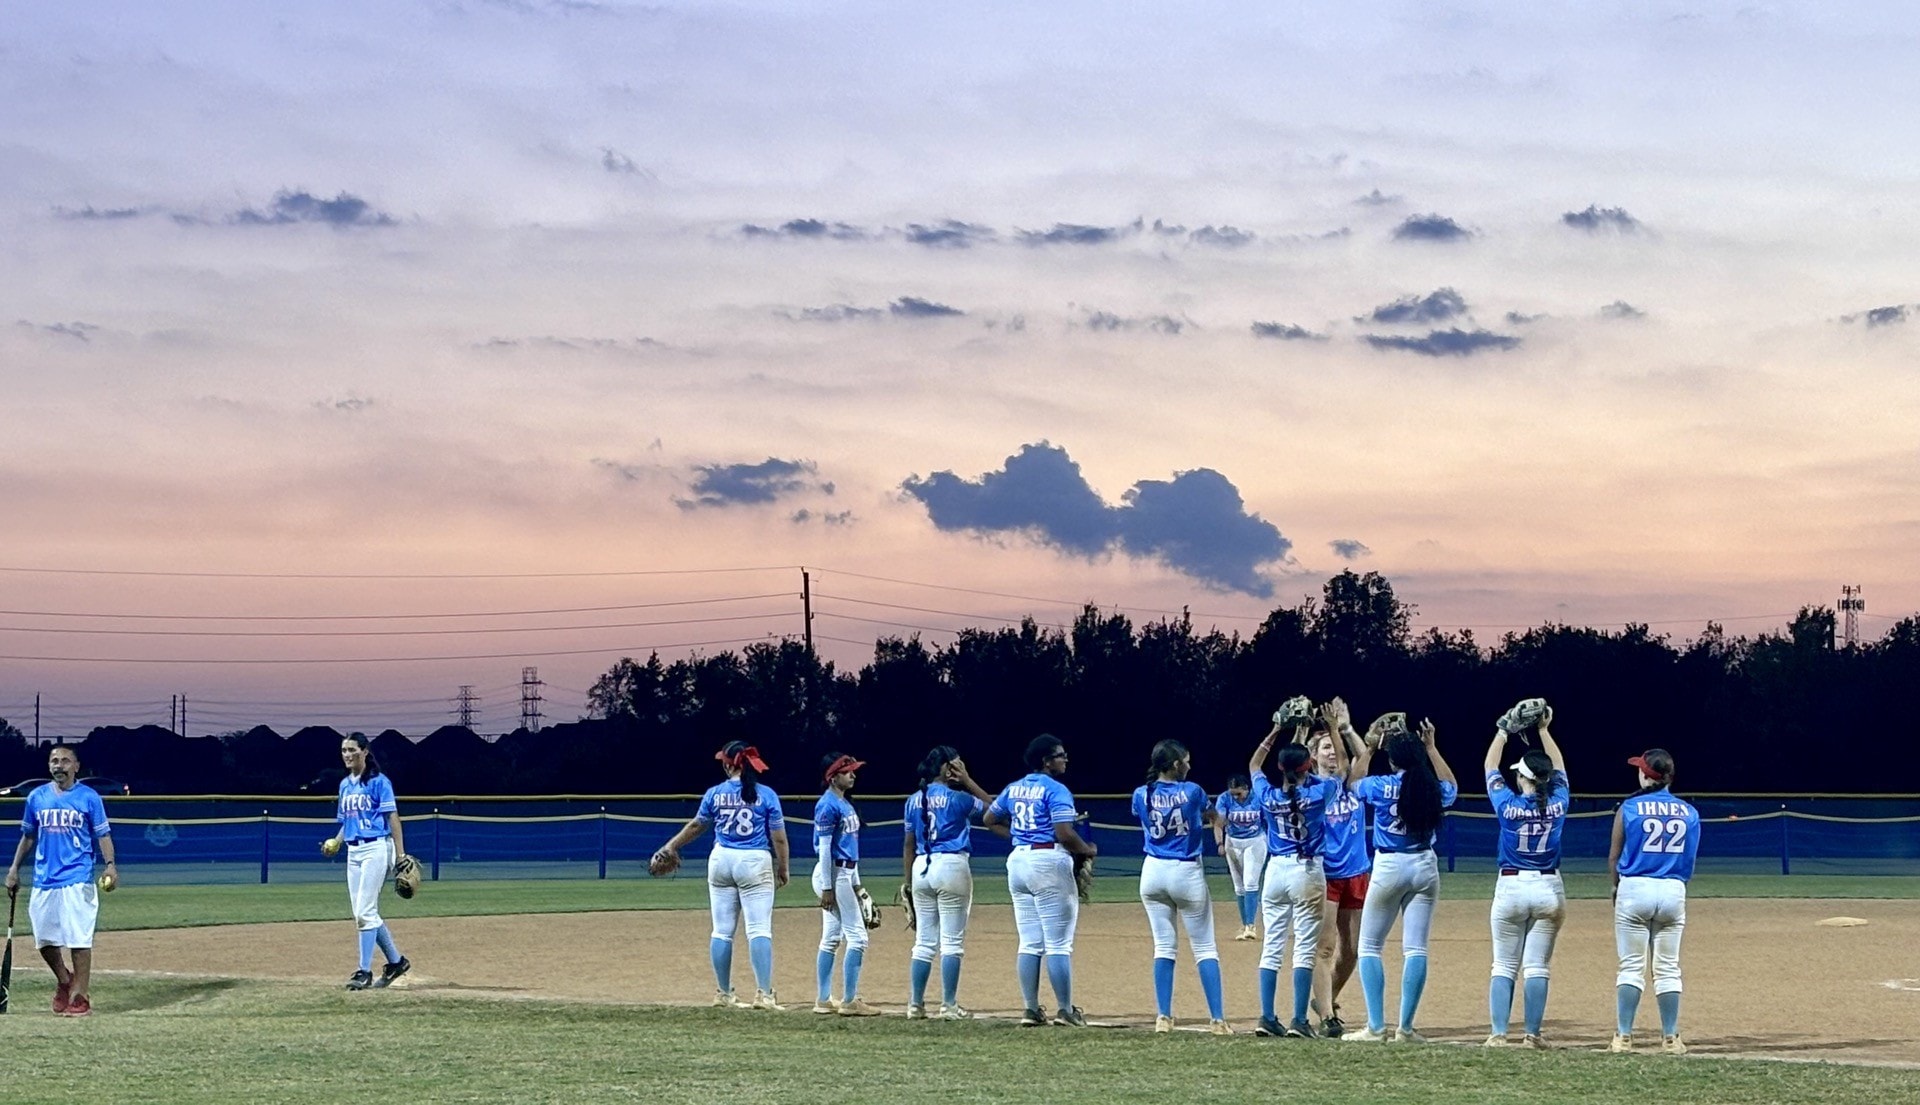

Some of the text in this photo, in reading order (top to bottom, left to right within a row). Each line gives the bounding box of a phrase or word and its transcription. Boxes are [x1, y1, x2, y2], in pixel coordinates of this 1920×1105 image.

[719, 807, 754, 836] 78
[1148, 807, 1190, 839] 34
[1642, 818, 1687, 853] 22
[1516, 822, 1553, 853] 17
